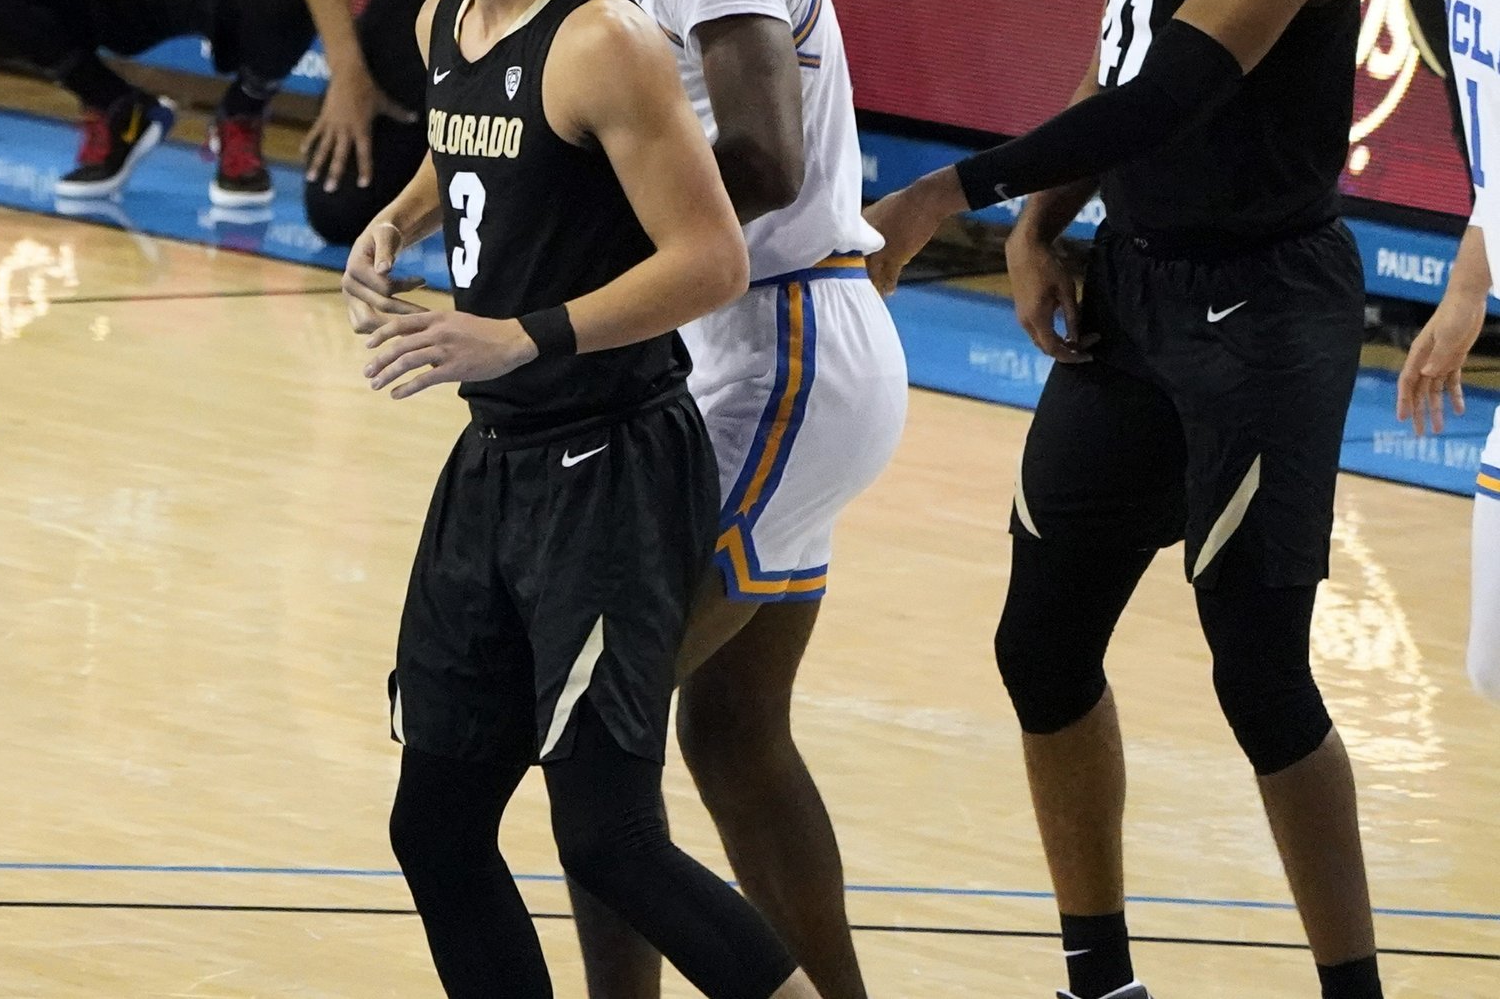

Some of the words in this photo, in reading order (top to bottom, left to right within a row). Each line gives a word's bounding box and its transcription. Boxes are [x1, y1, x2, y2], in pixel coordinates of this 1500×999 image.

[428, 107, 524, 159] COLORADO
[449, 171, 486, 288] 3
[1377, 247, 1446, 286] PAULEY
